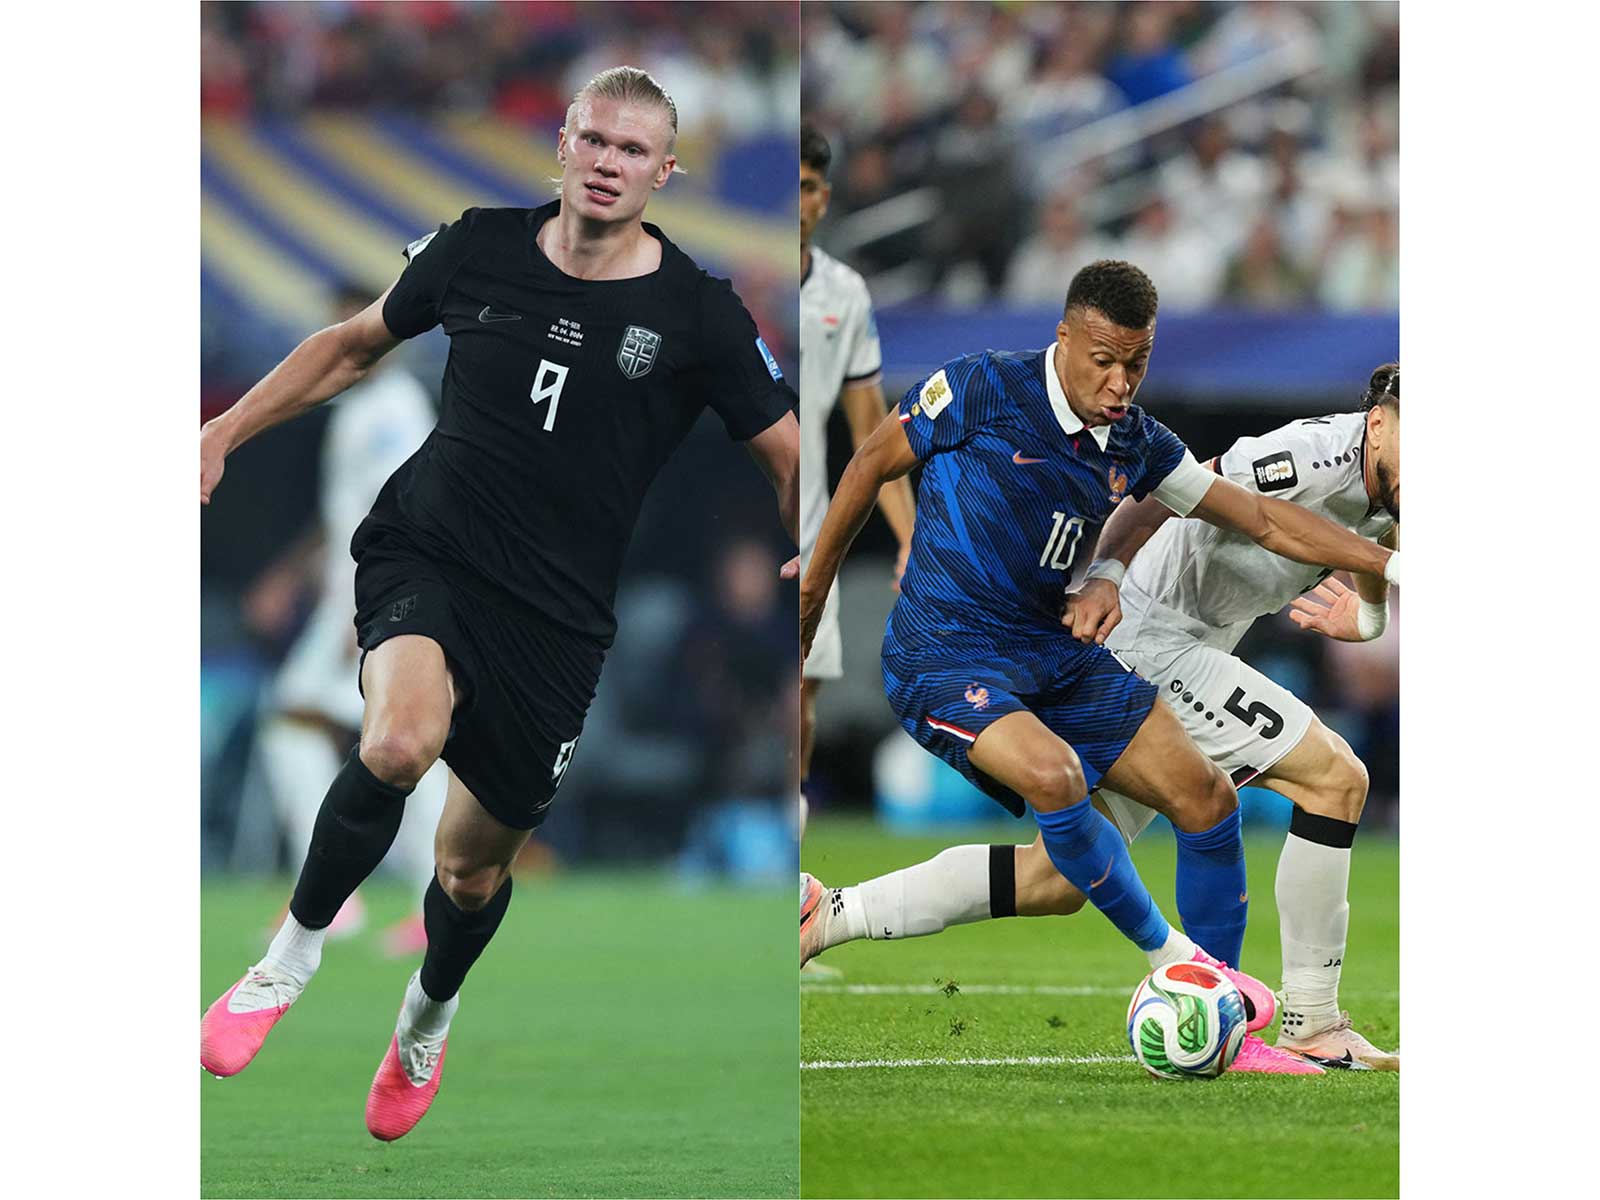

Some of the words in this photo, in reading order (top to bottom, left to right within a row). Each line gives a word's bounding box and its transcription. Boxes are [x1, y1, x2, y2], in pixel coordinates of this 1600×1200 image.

[529, 358, 570, 432] 9
[1039, 511, 1085, 571] 10
[1223, 686, 1285, 740] 5
